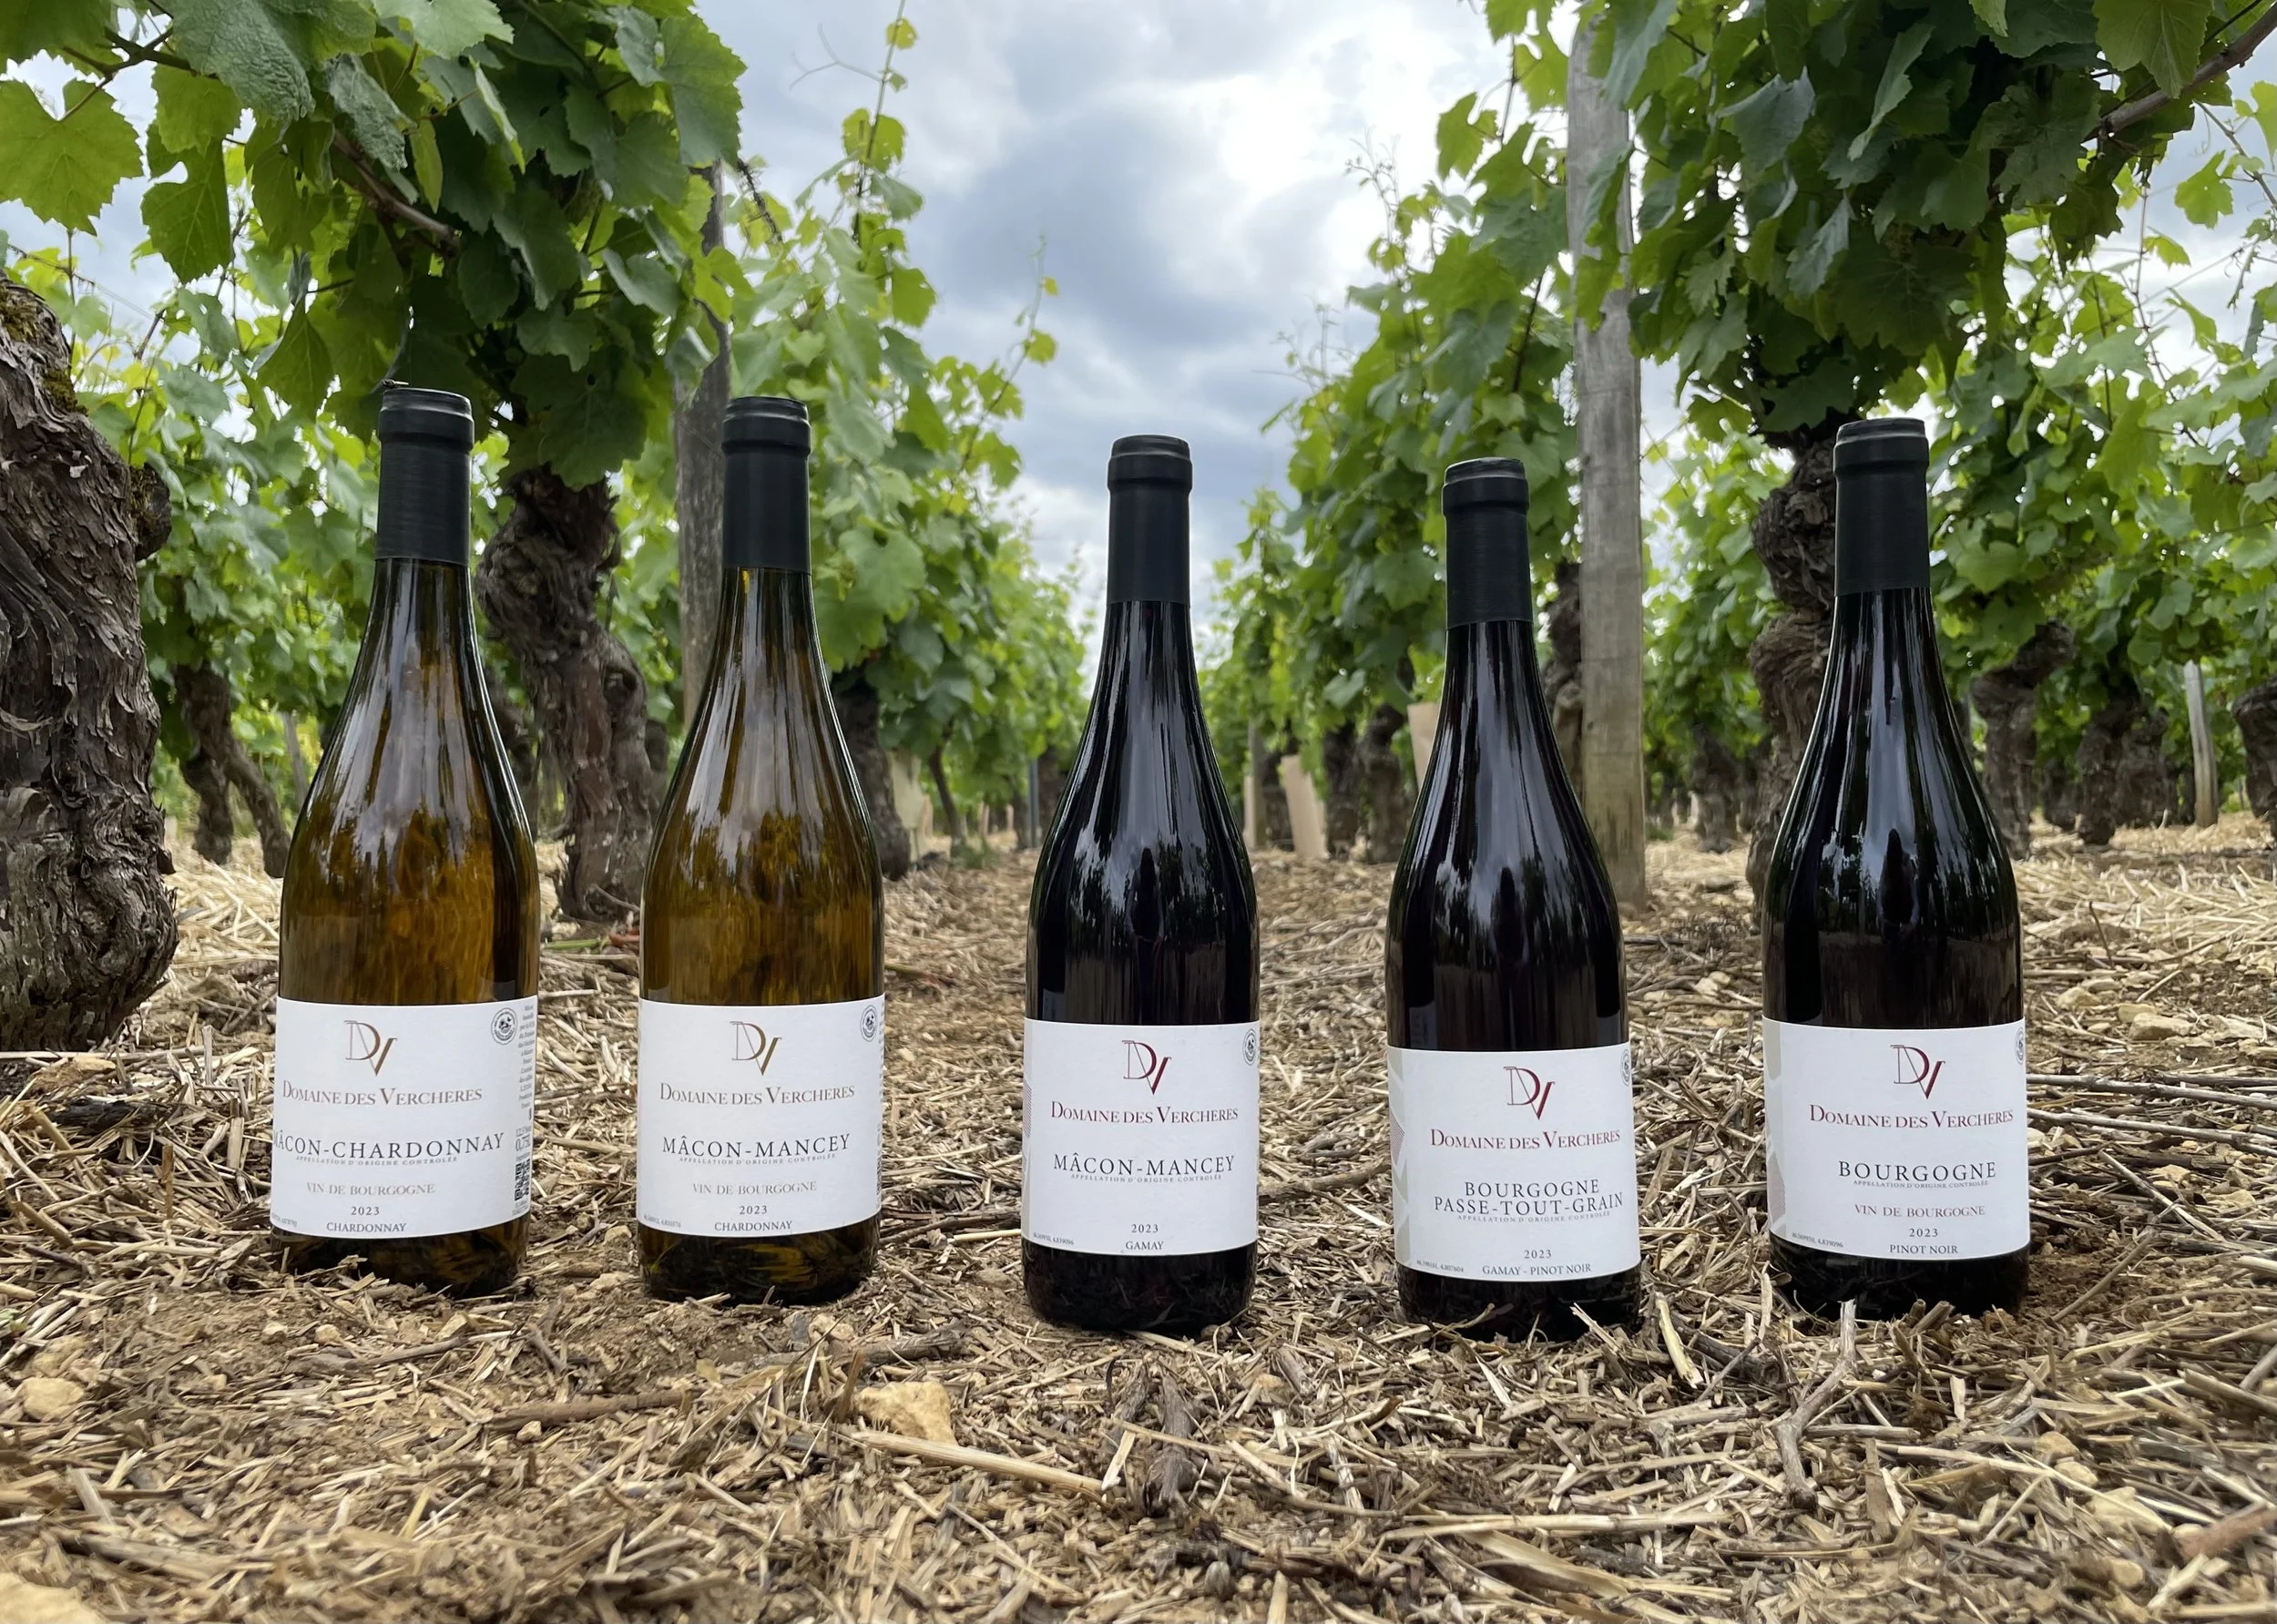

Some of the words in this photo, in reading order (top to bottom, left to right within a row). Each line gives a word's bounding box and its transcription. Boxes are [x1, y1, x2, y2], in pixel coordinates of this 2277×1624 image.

[343, 1019, 397, 1077] DV
[730, 1020, 782, 1076] DV
[1122, 1040, 1171, 1095] DV
[1890, 1044, 1945, 1099] DV
[282, 1080, 342, 1105] DOMAINE
[345, 1093, 376, 1106] DES
[380, 1088, 483, 1106] VERCHERES
[660, 1082, 729, 1105] DOMAINE
[732, 1093, 761, 1105] DES
[766, 1086, 854, 1105] VERCHERES
[1503, 1066, 1556, 1120] DV
[1050, 1101, 1119, 1122] DOMAINE
[1123, 1111, 1153, 1123] DES
[1157, 1107, 1239, 1123] VERCHERES
[1810, 1104, 1891, 1128] DOMAINE
[1895, 1117, 1927, 1129] DES
[1931, 1109, 2014, 1128] VERCHERES
[662, 1134, 851, 1158] MÂCON-MANCEY
[1430, 1129, 1506, 1149] DOMAINE
[1509, 1138, 1540, 1149] DES
[1542, 1129, 1620, 1149] VERCHERES
[296, 1155, 346, 1166] APPELLATION
[679, 1156, 733, 1165] APPELLATION
[1054, 1152, 1235, 1176] MÂCON-MANCEY
[1839, 1160, 1996, 1181] BOURGOGNE
[1071, 1174, 1126, 1182] APPELLATION
[306, 1182, 325, 1193] VIN
[329, 1183, 346, 1194] DE
[350, 1183, 435, 1195] BOURGOGNE
[692, 1183, 710, 1194] VIN
[717, 1184, 733, 1195] DE
[739, 1181, 817, 1195] BOURGOGNE
[1465, 1179, 1599, 1198] BOURGOGNE
[739, 1205, 768, 1215] 2023
[1435, 1192, 1623, 1215] PASSE-TOUT-GRAIN
[1854, 1204, 1876, 1215] VIN
[1883, 1206, 1901, 1217] DE
[1907, 1206, 1986, 1217] BOURGOGNE
[351, 1206, 380, 1216] 2023
[1457, 1214, 1516, 1222] APPELLATION
[326, 1221, 407, 1232] CHARDONNAY
[714, 1221, 792, 1231] CHARDONNAY
[1131, 1224, 1159, 1233] 2023
[1909, 1228, 1938, 1238] 2023
[1126, 1241, 1164, 1251] GAMAY
[1889, 1244, 1925, 1254] PINOT
[1928, 1244, 1958, 1254] NOIR
[1524, 1250, 1552, 1259] 2023
[1482, 1265, 1521, 1276] GAMAY
[1529, 1265, 1564, 1275] PINOT
[1566, 1262, 1592, 1273] NOIR
